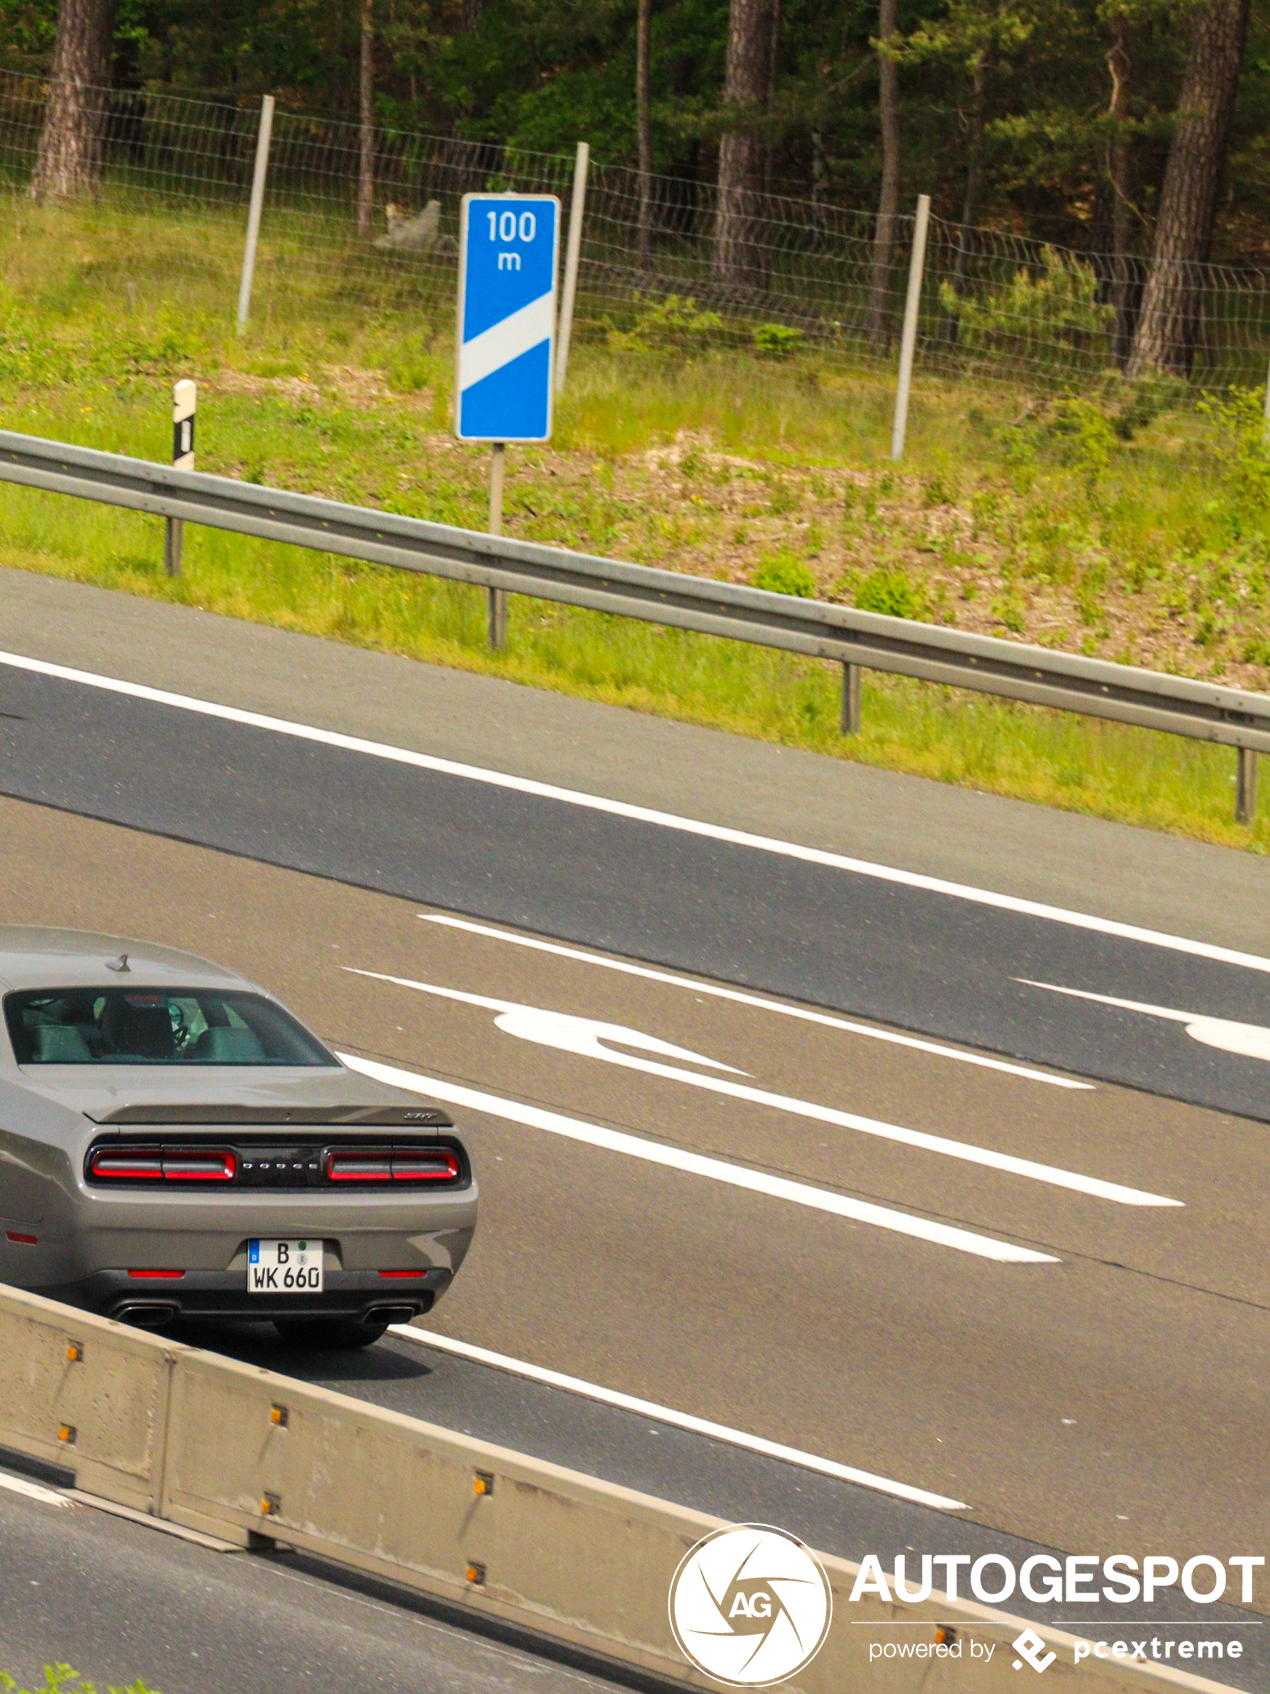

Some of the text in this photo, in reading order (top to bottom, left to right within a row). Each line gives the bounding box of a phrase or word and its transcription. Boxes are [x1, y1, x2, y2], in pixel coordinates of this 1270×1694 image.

[487, 211, 536, 242] 100
[497, 252, 521, 271] m
[277, 1243, 289, 1264] B
[253, 1267, 319, 1288] WK 660
